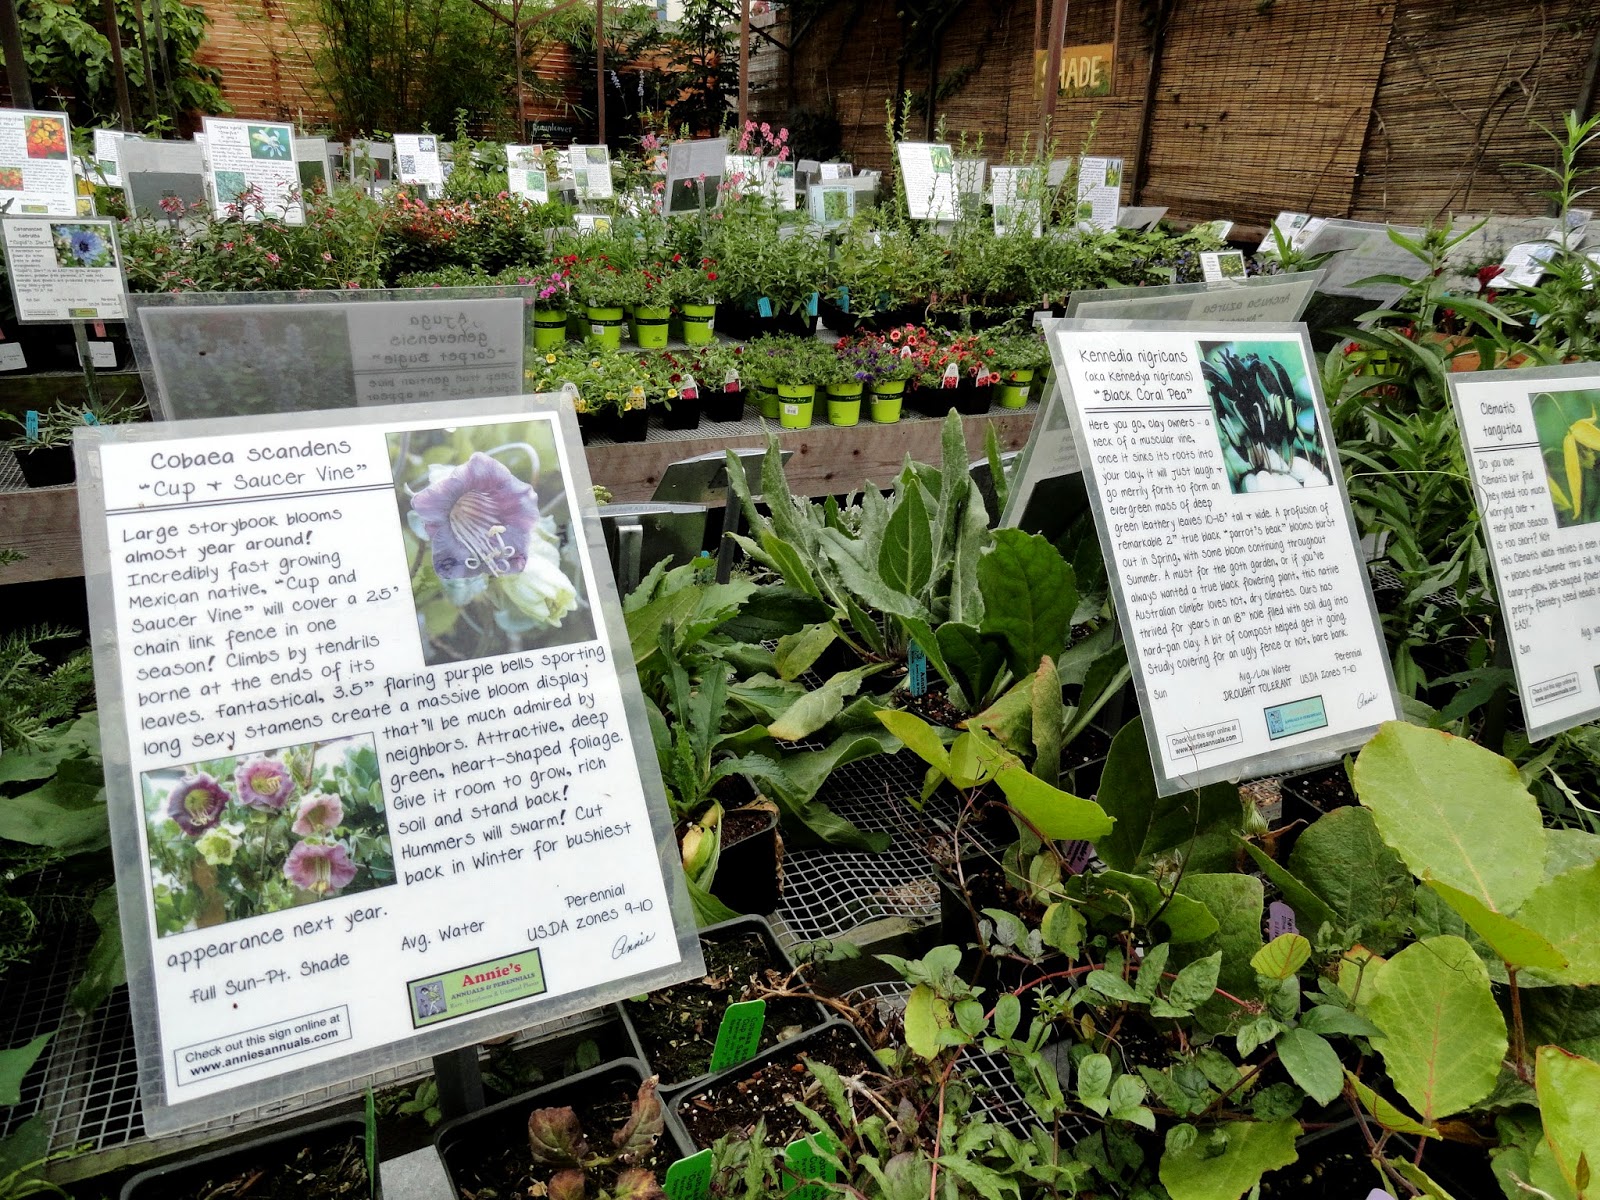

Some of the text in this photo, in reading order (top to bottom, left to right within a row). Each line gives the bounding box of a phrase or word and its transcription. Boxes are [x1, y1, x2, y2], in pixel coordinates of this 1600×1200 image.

[1078, 348, 1188, 369] Kennedia nigricans
[1084, 370, 1193, 386] (aka Kennedya nigricans)
[1135, 387, 1164, 401] Coral
[1479, 400, 1515, 415] Clematis
[1482, 421, 1522, 441] tangutica
[150, 440, 351, 469] Cobaea scandens
[1096, 448, 1213, 464] once it sinks its roots into
[233, 471, 306, 490] Saucer
[1109, 497, 1212, 518] evergreen mass of deep
[122, 508, 342, 544] Large storybook blooms
[124, 529, 313, 563] almost year around!
[127, 551, 341, 587] Incredibly fast growing
[129, 591, 199, 609] Mexican
[207, 582, 267, 600] native,
[327, 568, 356, 585] and
[1135, 582, 1333, 620] Australian climber loves hot, dry climates. Ours has
[133, 618, 336, 656] chain link fence in one
[1519, 643, 1531, 655] Sun
[135, 634, 380, 681] season! Climbs by tendrils
[1333, 648, 1362, 661] Perennial
[1222, 677, 1292, 701] DROUGHT TOLERANT
[1238, 663, 1291, 684] Avg./Low Water
[1299, 663, 1356, 684] USDA Zones 7-10
[385, 711, 608, 765] neighbors. Attractive, deep
[390, 731, 623, 793] green, heart-shaped foliage.
[392, 756, 606, 810] Give it room to grow, rich
[397, 784, 569, 835] soil and stand back!
[401, 803, 603, 860] Hummers will swarm! Cut
[403, 821, 631, 886] back in Winter for bushiest
[563, 882, 625, 908] Perennial
[526, 898, 653, 942] USDA zones 9-10
[166, 906, 387, 972] appearance next year.
[224, 968, 291, 996] Sun-Pt.
[299, 952, 350, 976] Shade
[450, 986, 484, 1000] ANNUALS
[493, 972, 536, 989] PERENNIALS
[462, 962, 522, 988] Annie's
[184, 1013, 340, 1063] Check out this sign online at
[189, 1029, 338, 1076] www.anniesannuals.com
